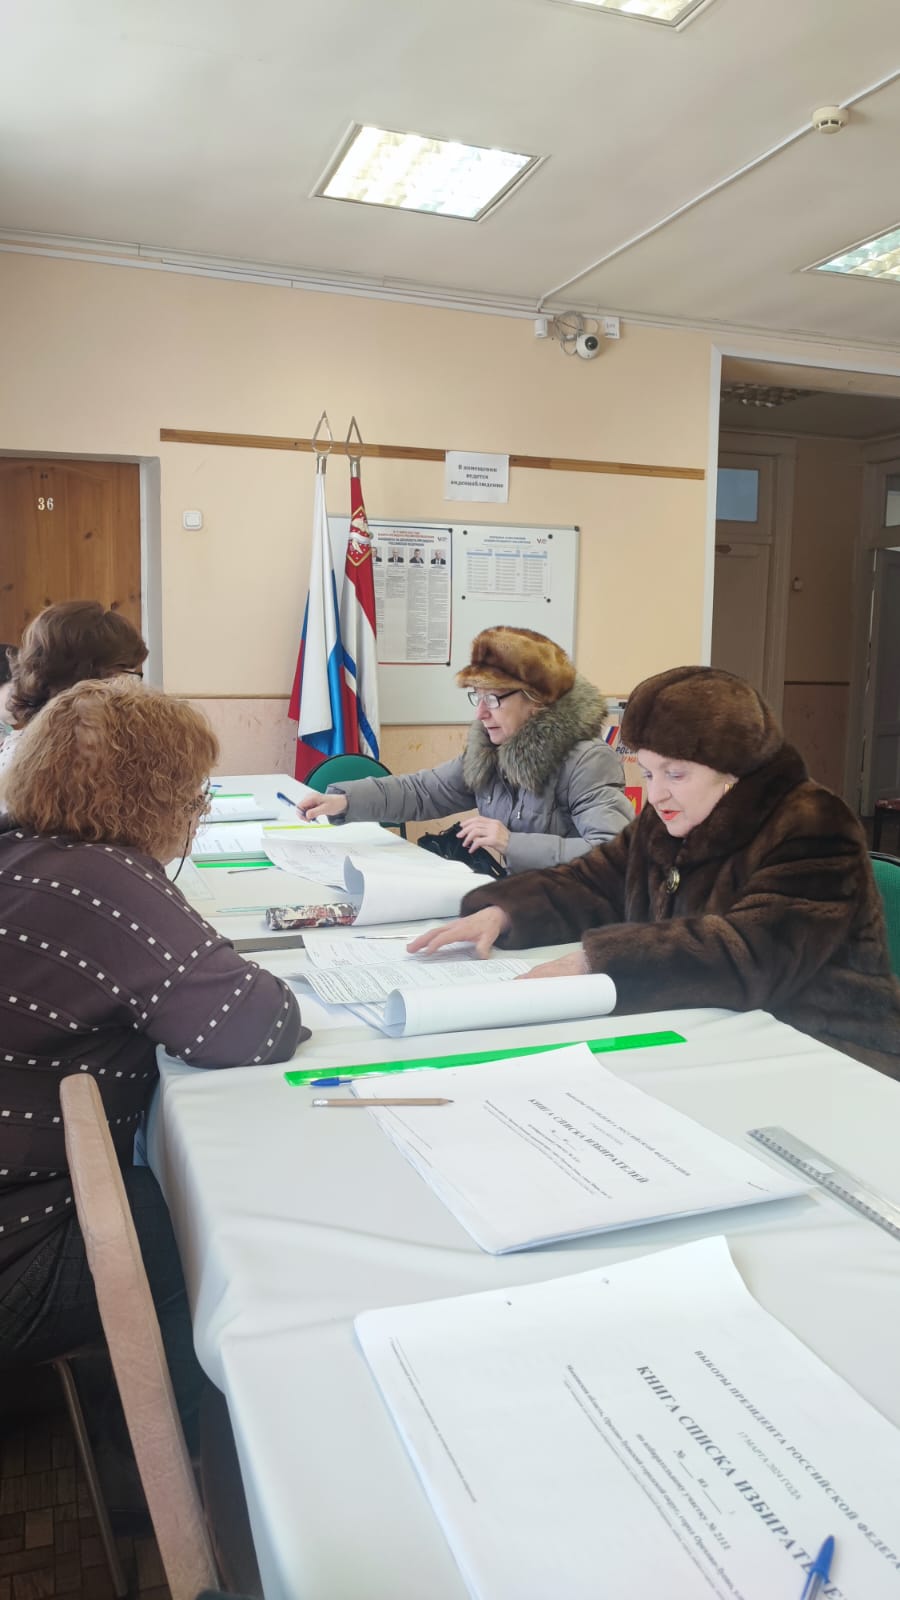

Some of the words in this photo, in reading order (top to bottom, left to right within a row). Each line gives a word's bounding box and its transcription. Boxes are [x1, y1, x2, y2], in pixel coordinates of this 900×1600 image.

[38, 497, 54, 511] 36
[584, 1138, 650, 1183] ИЗБИРАТЕЛЕЙ
[636, 1366, 680, 1413] КНИГА
[678, 1415, 737, 1477] СПИСКА
[694, 1350, 732, 1387] ВЫБОРЫ
[729, 1387, 787, 1445] ПРЕЗИДЕНТА
[785, 1445, 859, 1521] РОССИЙСКОЙ
